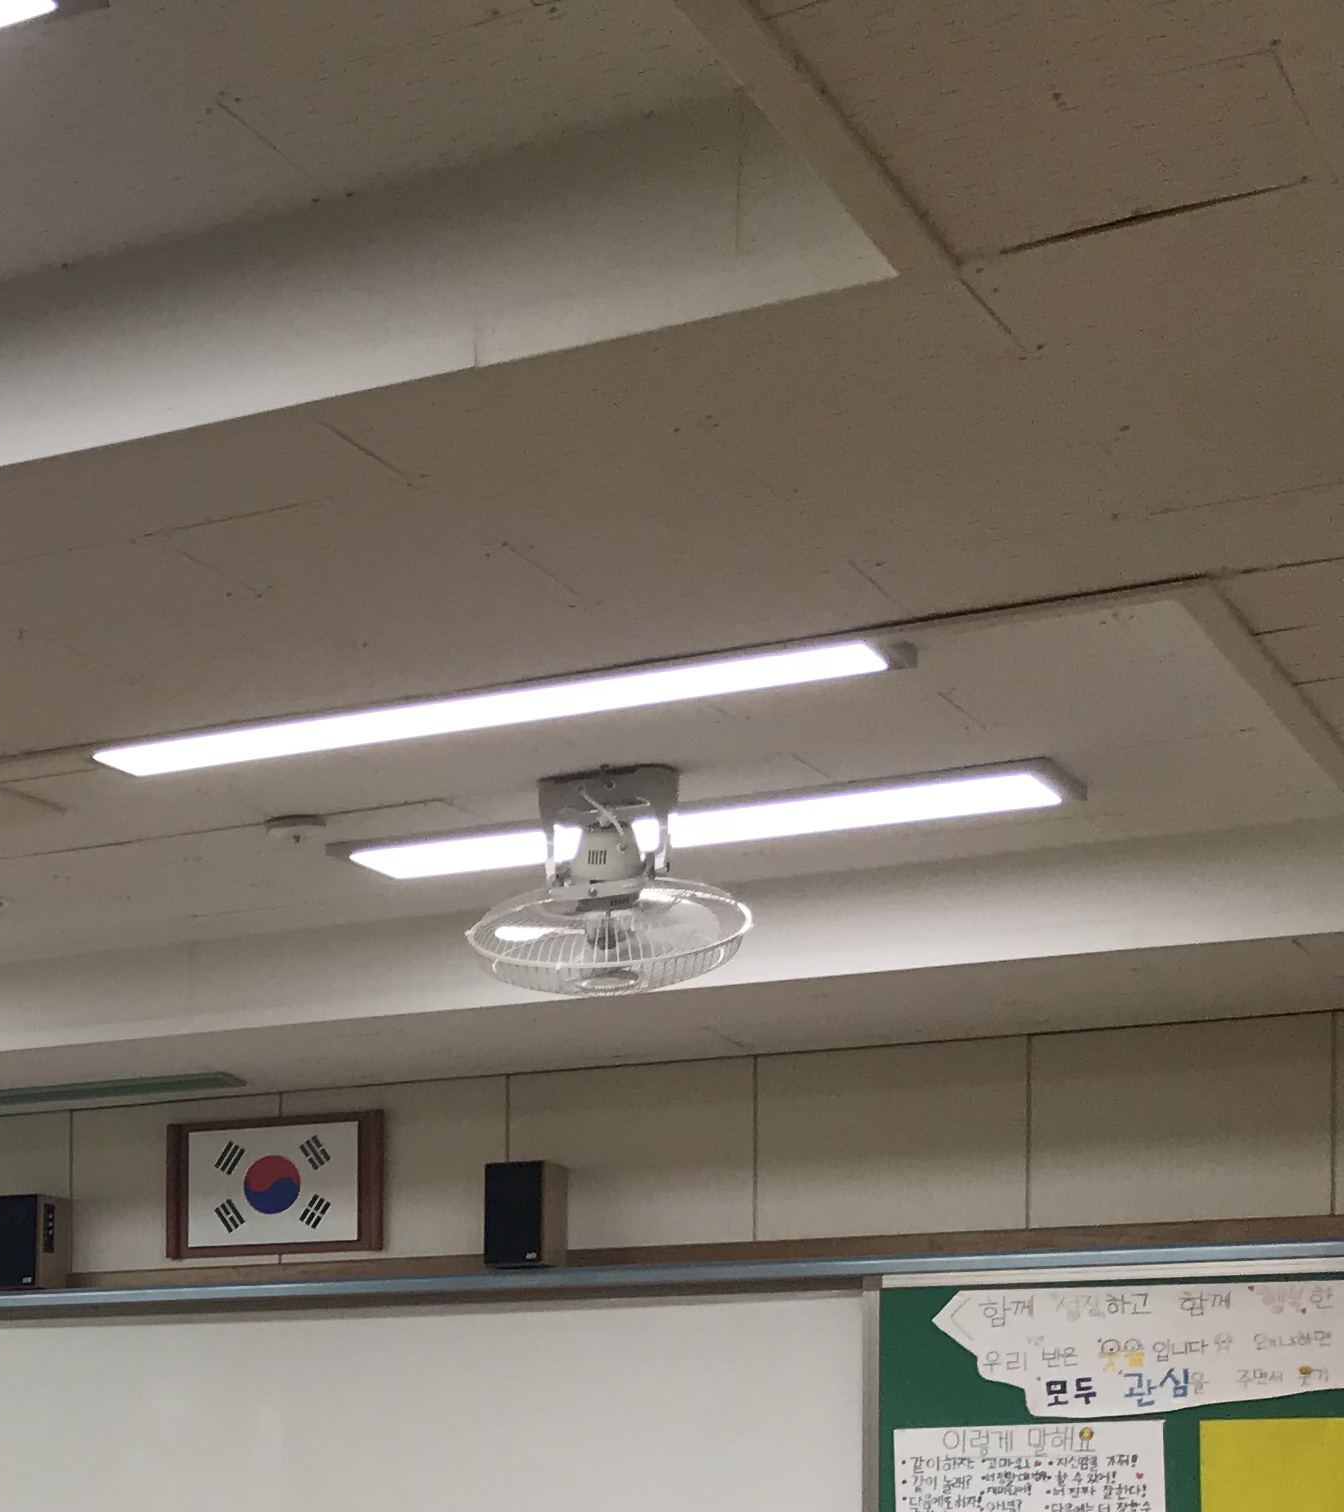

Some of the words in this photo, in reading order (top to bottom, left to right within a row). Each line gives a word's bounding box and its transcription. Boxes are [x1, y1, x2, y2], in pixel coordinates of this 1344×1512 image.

[979, 1294, 1034, 1328] 함께
[1178, 1290, 1232, 1317] 함께
[983, 1350, 1028, 1373] 우리
[1042, 1346, 1078, 1368] 반은
[1153, 1338, 1208, 1362] 입니다
[1046, 1376, 1097, 1407] 모두
[943, 1428, 1014, 1457] 이렇게
[1027, 1426, 1096, 1458] 말해요
[1072, 1471, 1084, 1484] 수
